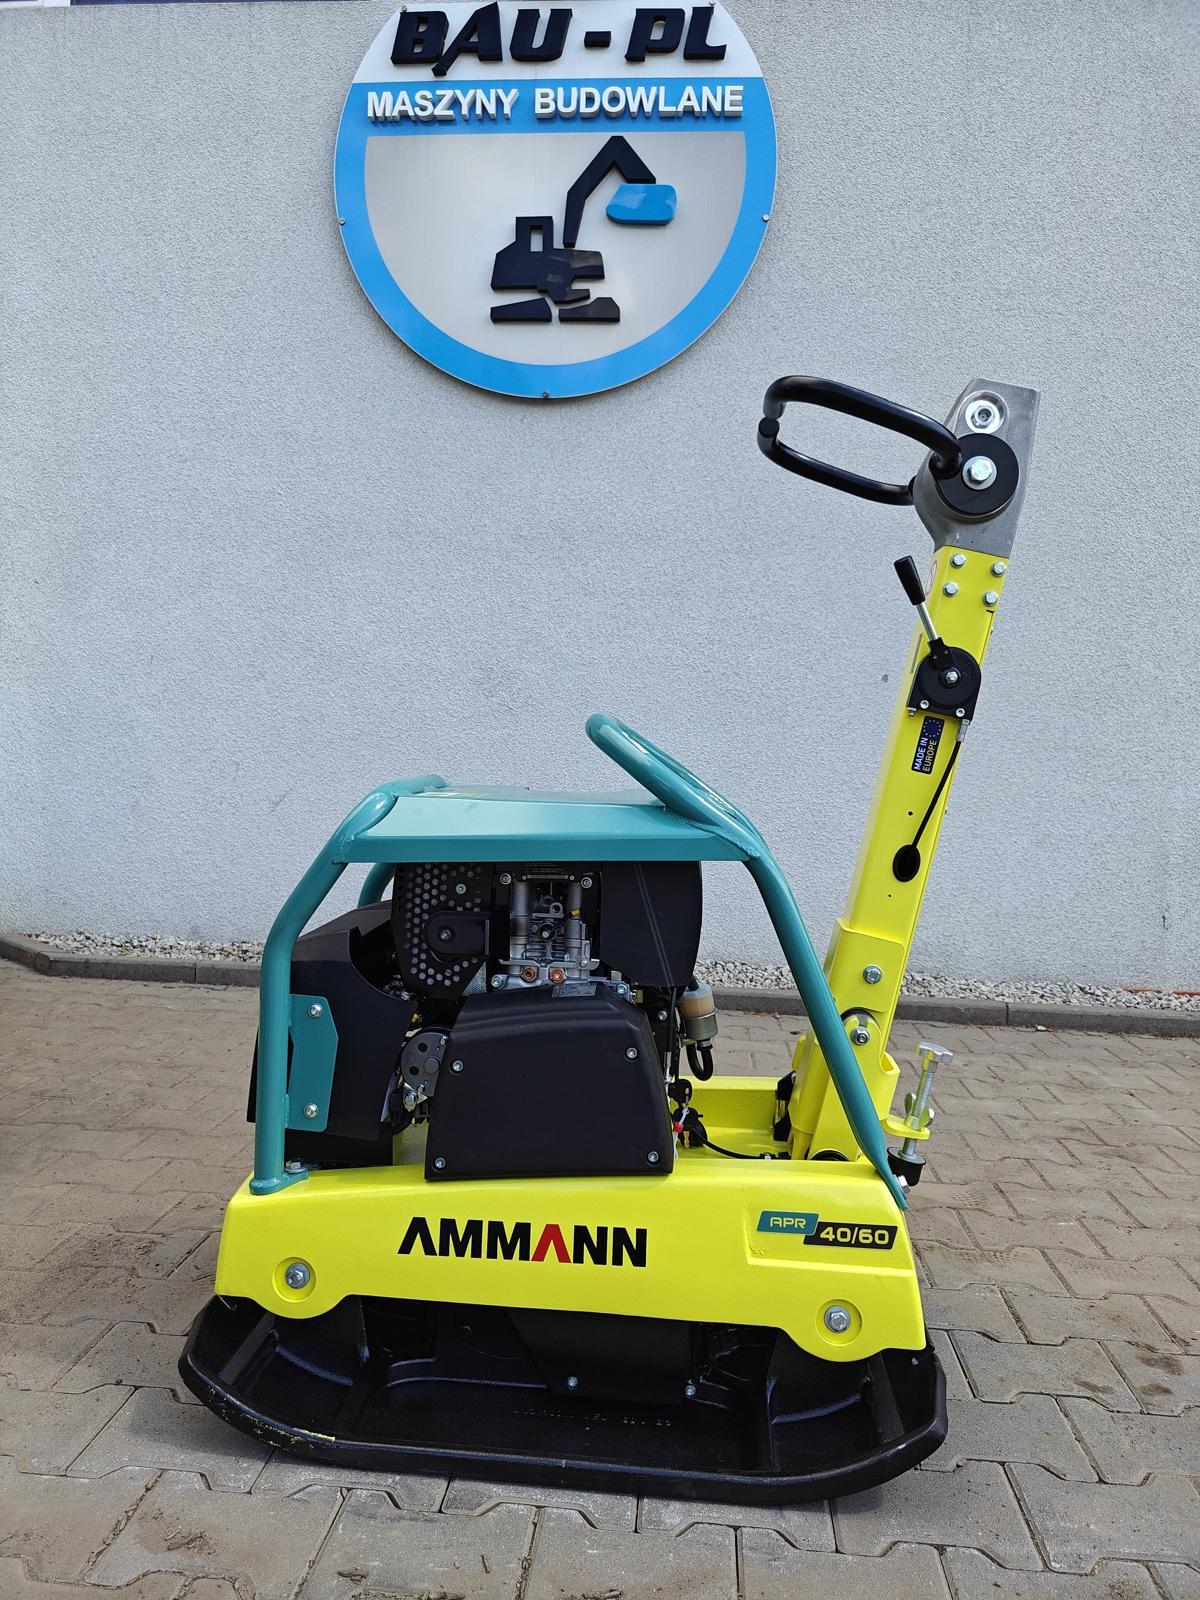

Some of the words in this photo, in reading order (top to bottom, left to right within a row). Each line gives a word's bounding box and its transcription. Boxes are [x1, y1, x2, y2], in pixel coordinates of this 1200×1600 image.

[390, 1, 573, 76] BAU
[366, 88, 519, 122] MASZYNY
[534, 85, 744, 120] BUDOWLANE
[913, 747, 926, 770] MADE
[920, 737, 929, 746] IN
[922, 740, 937, 772] EUROPE
[397, 1216, 647, 1267] AMMANN
[769, 1216, 807, 1229] APR
[819, 1227, 889, 1245] 40/60
